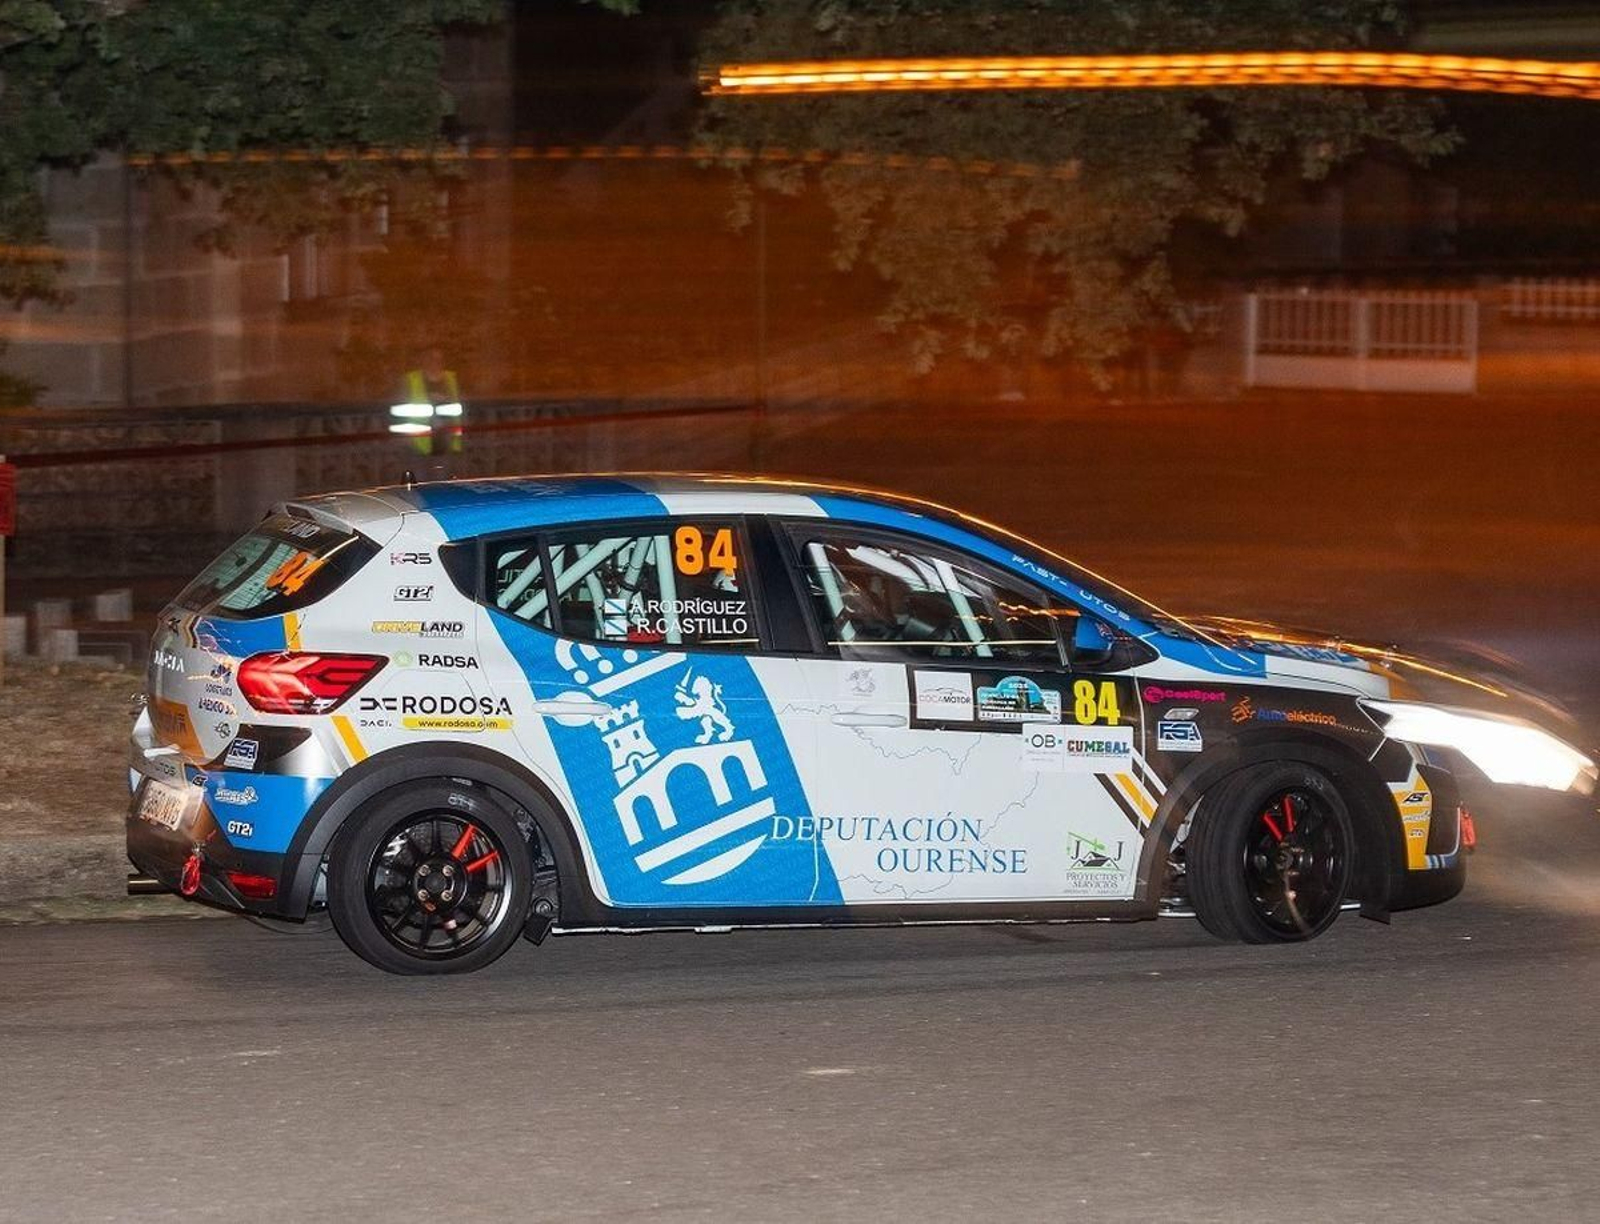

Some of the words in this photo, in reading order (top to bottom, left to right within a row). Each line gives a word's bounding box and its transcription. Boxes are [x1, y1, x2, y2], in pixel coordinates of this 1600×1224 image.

[674, 526, 737, 577] 84
[266, 551, 324, 596] 84
[629, 597, 747, 615] A.RODRÍGUEZ
[637, 618, 748, 635] R.CASTILLO
[418, 654, 479, 670] RADSA
[402, 696, 513, 716] RODOSA
[1073, 679, 1121, 726] 84
[1031, 734, 1056, 748] OB
[771, 811, 983, 842] DEPUTACIÓN
[877, 846, 1028, 875] OURENSE
[1070, 840, 1081, 860] J
[1113, 841, 1125, 862] J
